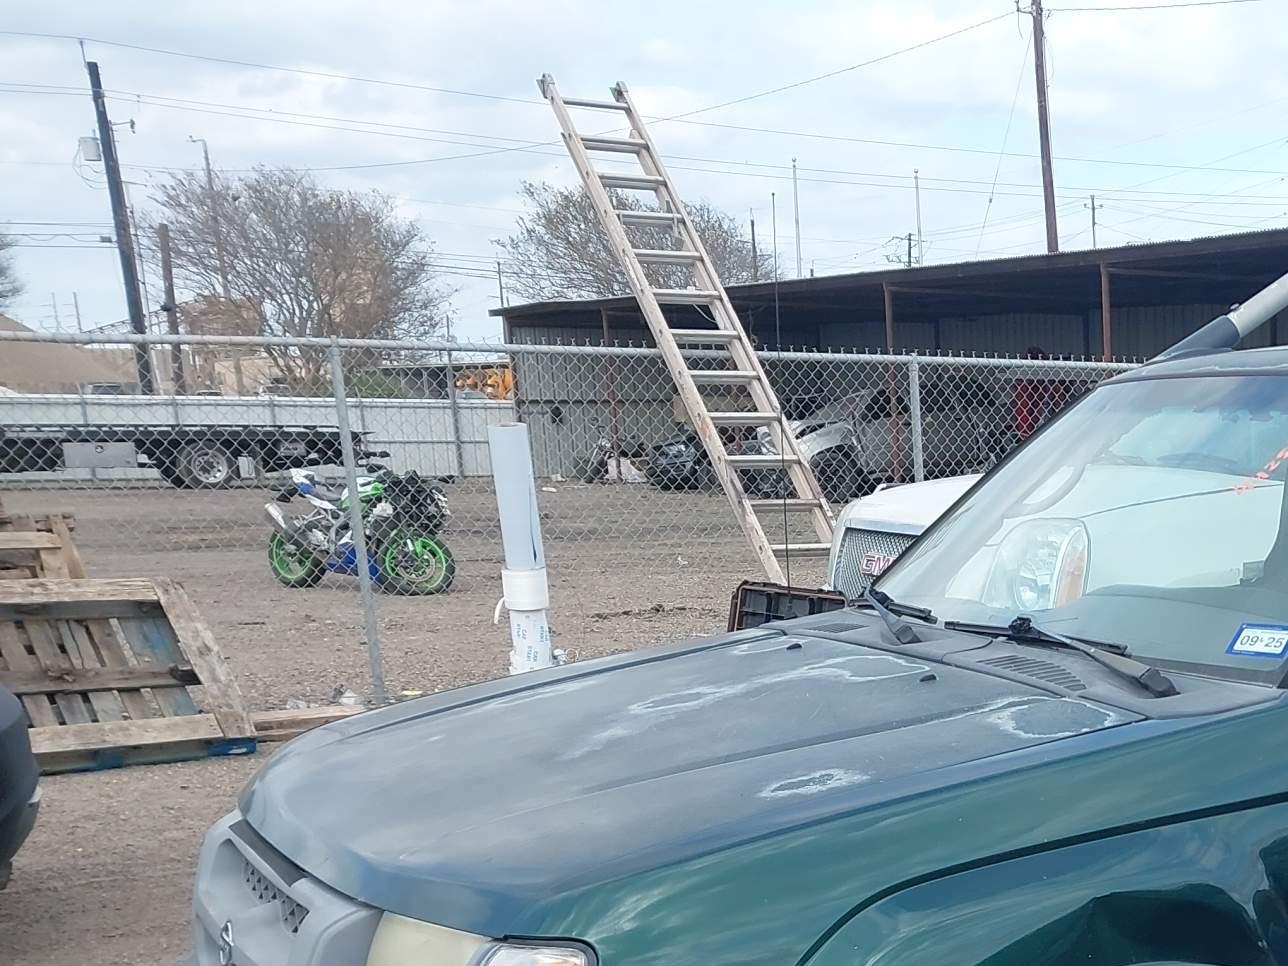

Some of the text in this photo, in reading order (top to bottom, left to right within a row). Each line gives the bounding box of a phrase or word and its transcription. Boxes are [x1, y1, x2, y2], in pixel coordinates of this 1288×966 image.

[861, 552, 898, 576] GM
[1240, 635, 1285, 648] 09 25
